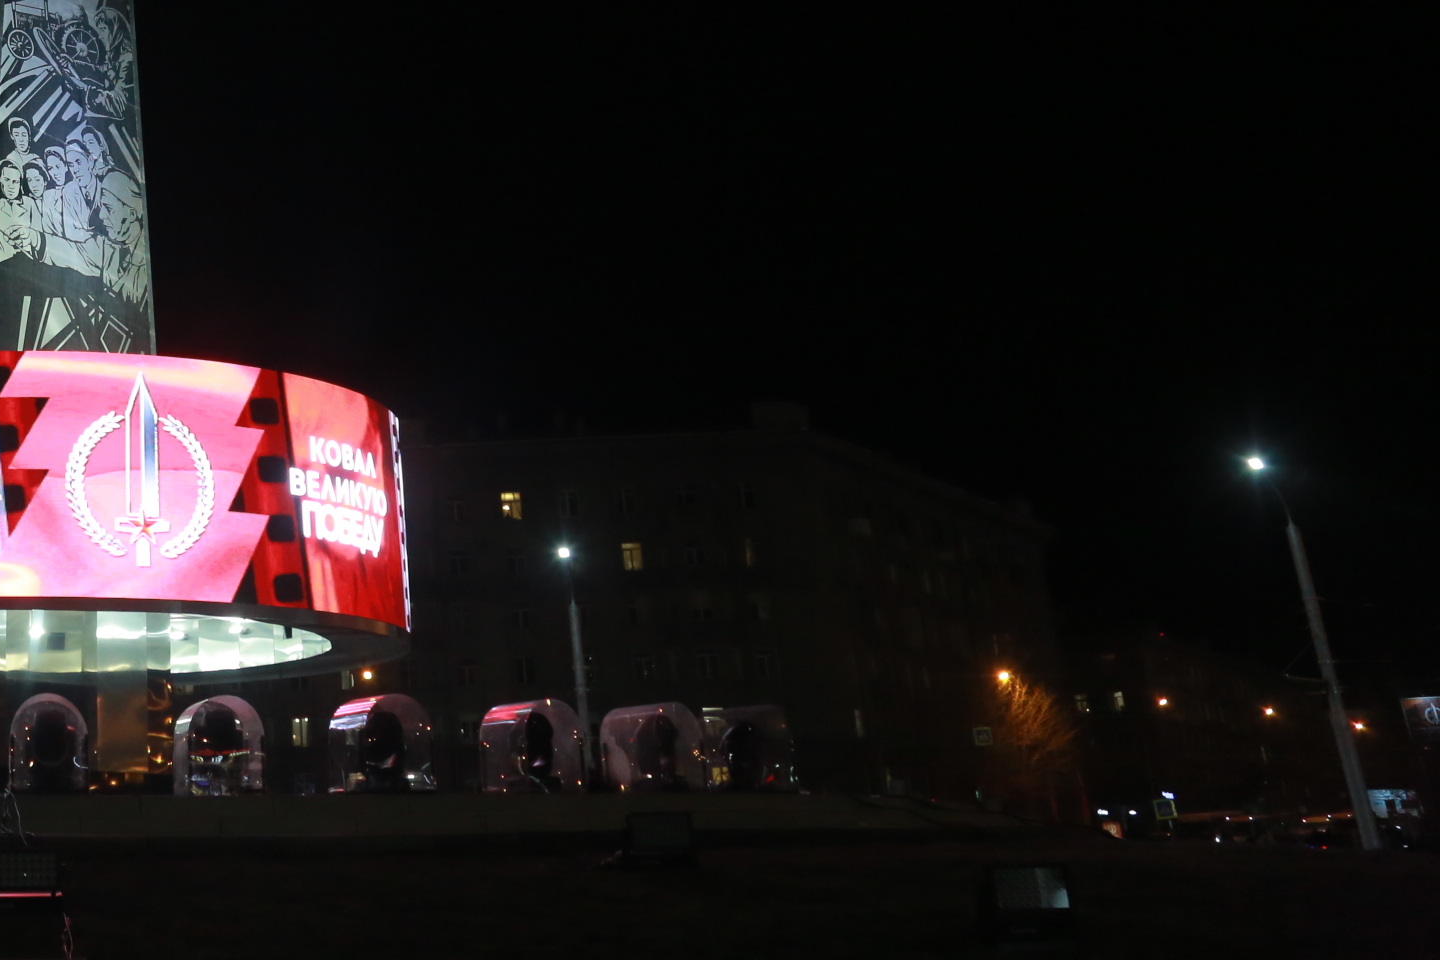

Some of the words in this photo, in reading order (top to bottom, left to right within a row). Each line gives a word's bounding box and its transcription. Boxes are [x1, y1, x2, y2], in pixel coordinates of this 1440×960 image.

[309, 435, 377, 479] КОВАЛ
[288, 467, 388, 517] ВЕЛИКУЮ
[301, 499, 385, 558] ПОБЕДУ
